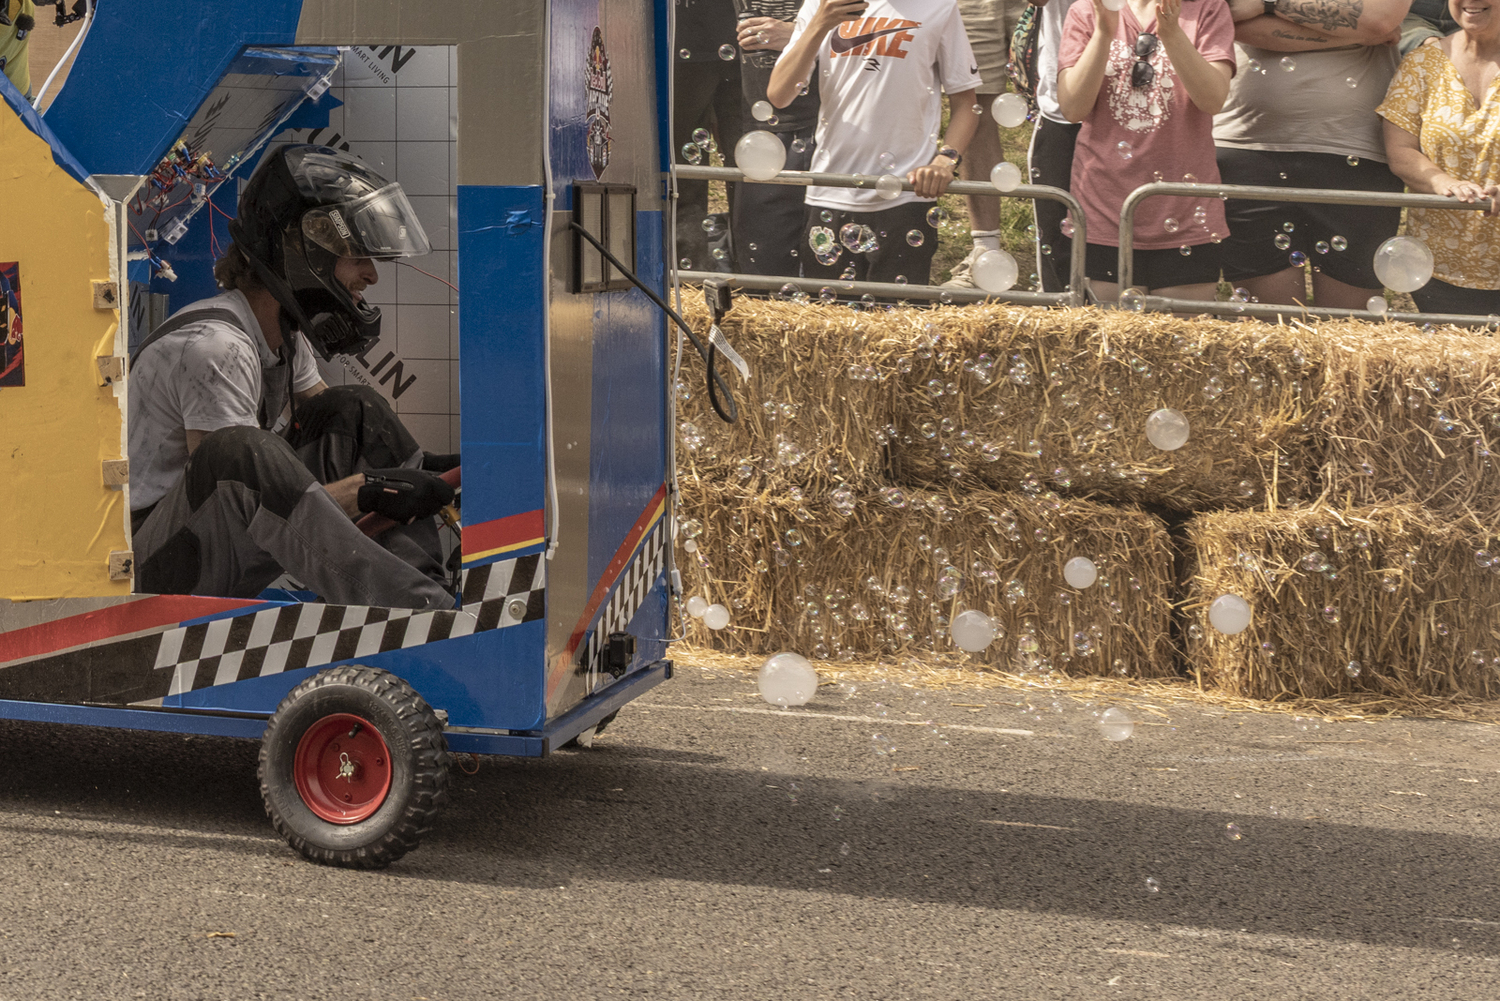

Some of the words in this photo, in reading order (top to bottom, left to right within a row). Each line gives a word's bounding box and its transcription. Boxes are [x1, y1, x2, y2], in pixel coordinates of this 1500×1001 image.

[830, 16, 922, 59] NIKE
[350, 45, 370, 64] MART
[368, 61, 390, 84] LIVING
[330, 211, 349, 238] SIMPSON
